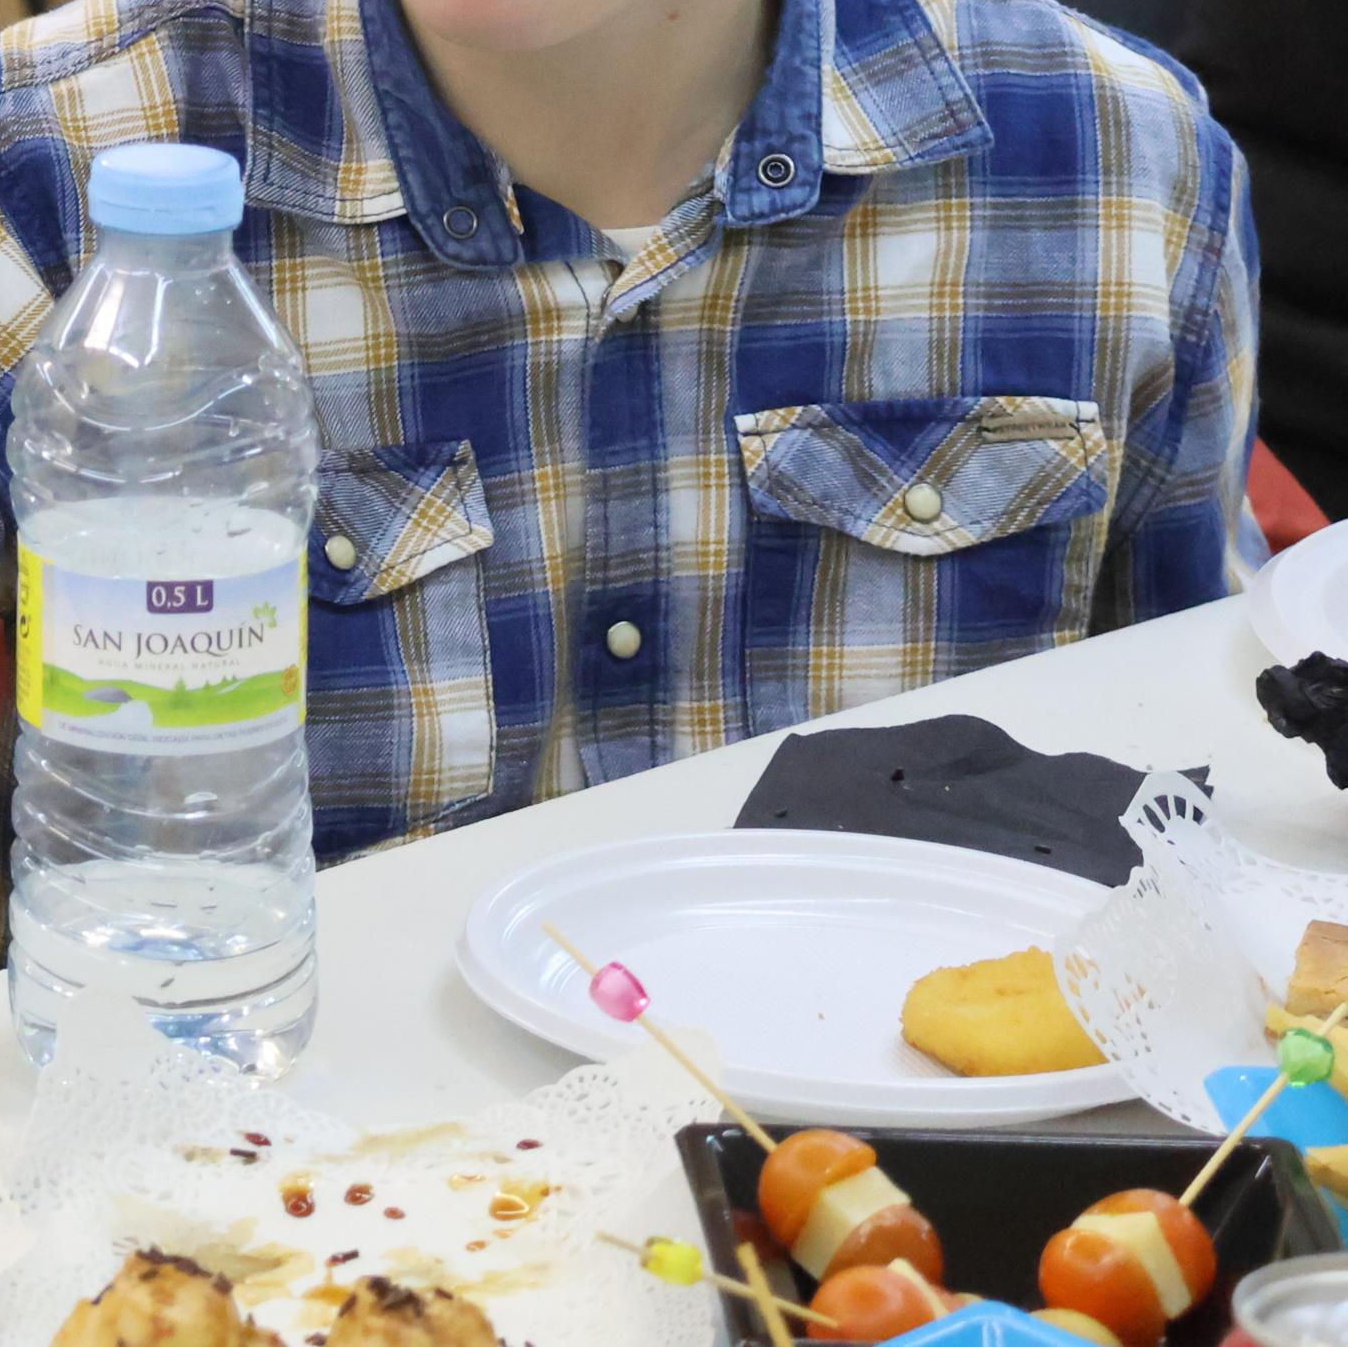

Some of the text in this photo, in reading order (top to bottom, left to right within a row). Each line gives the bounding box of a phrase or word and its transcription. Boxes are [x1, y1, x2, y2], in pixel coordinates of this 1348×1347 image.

[151, 585, 209, 609] 0,5 L
[72, 620, 265, 659] SAN JOAQUÍN
